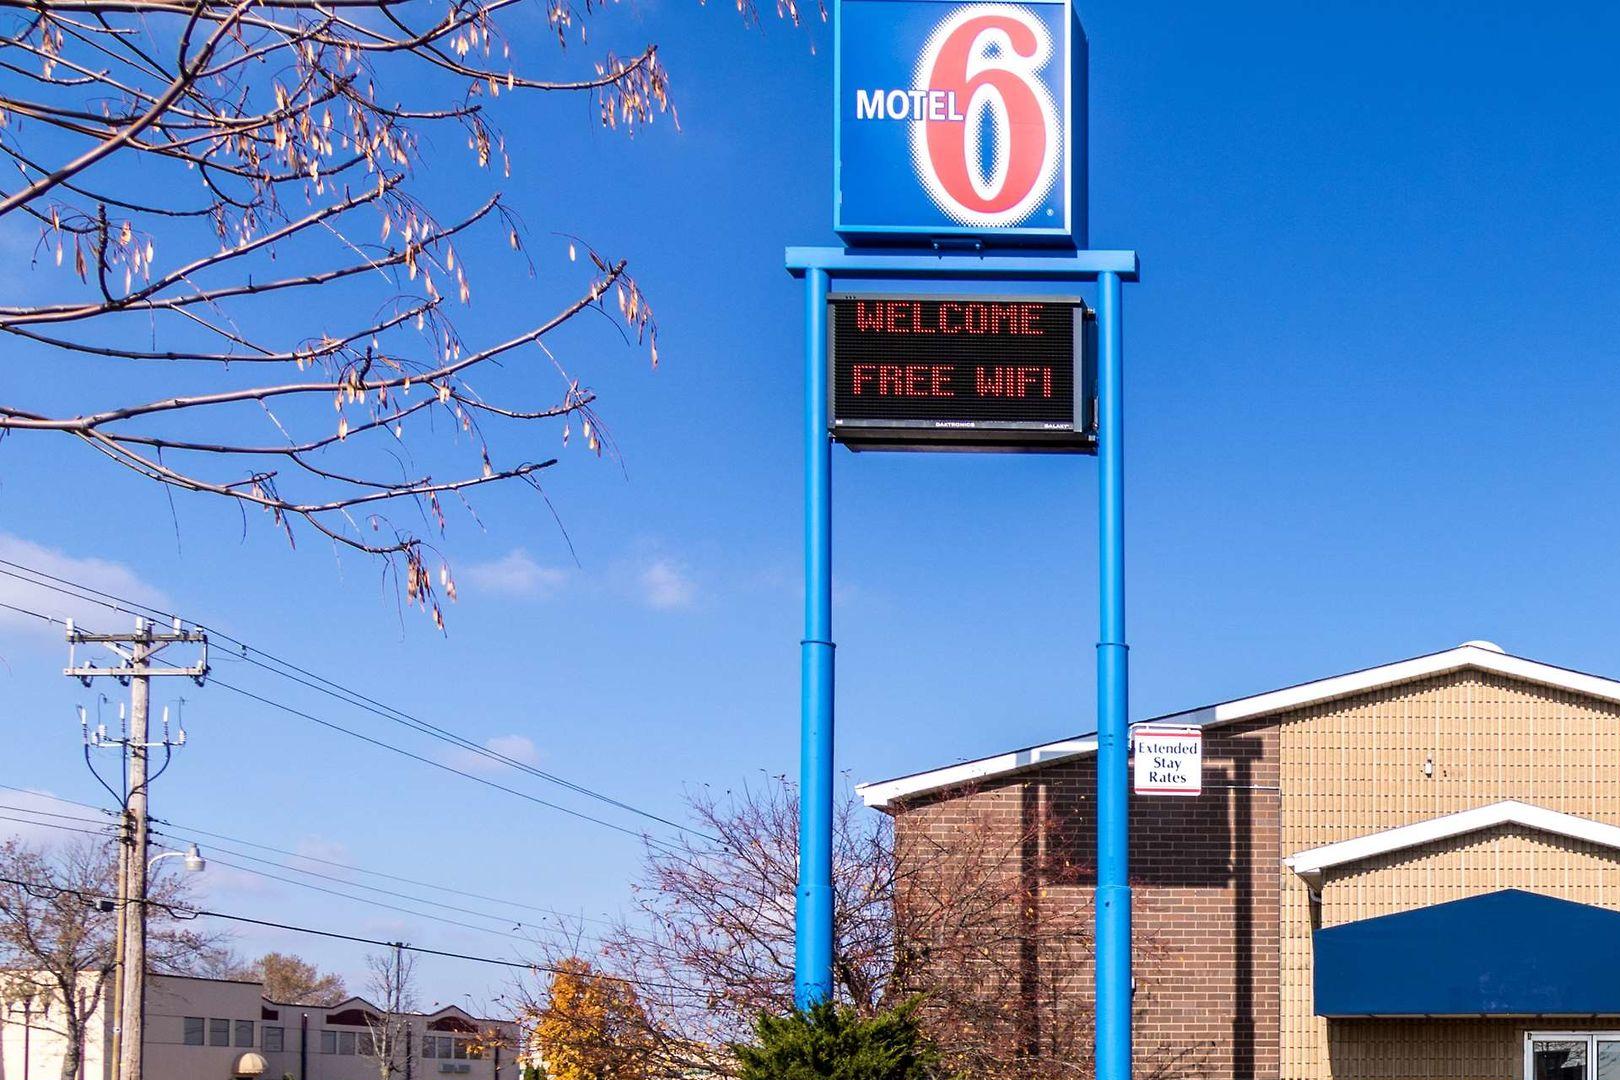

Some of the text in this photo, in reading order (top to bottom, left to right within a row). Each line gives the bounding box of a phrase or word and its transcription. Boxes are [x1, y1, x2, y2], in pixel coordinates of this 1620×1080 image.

[856, 14, 1047, 214] MOTEL 6
[857, 302, 1044, 334] WELCOME
[853, 365, 1051, 398] FREE WIFI
[1139, 742, 1198, 754] Extended
[1153, 757, 1182, 771] Stay
[1149, 771, 1187, 783] Rates
